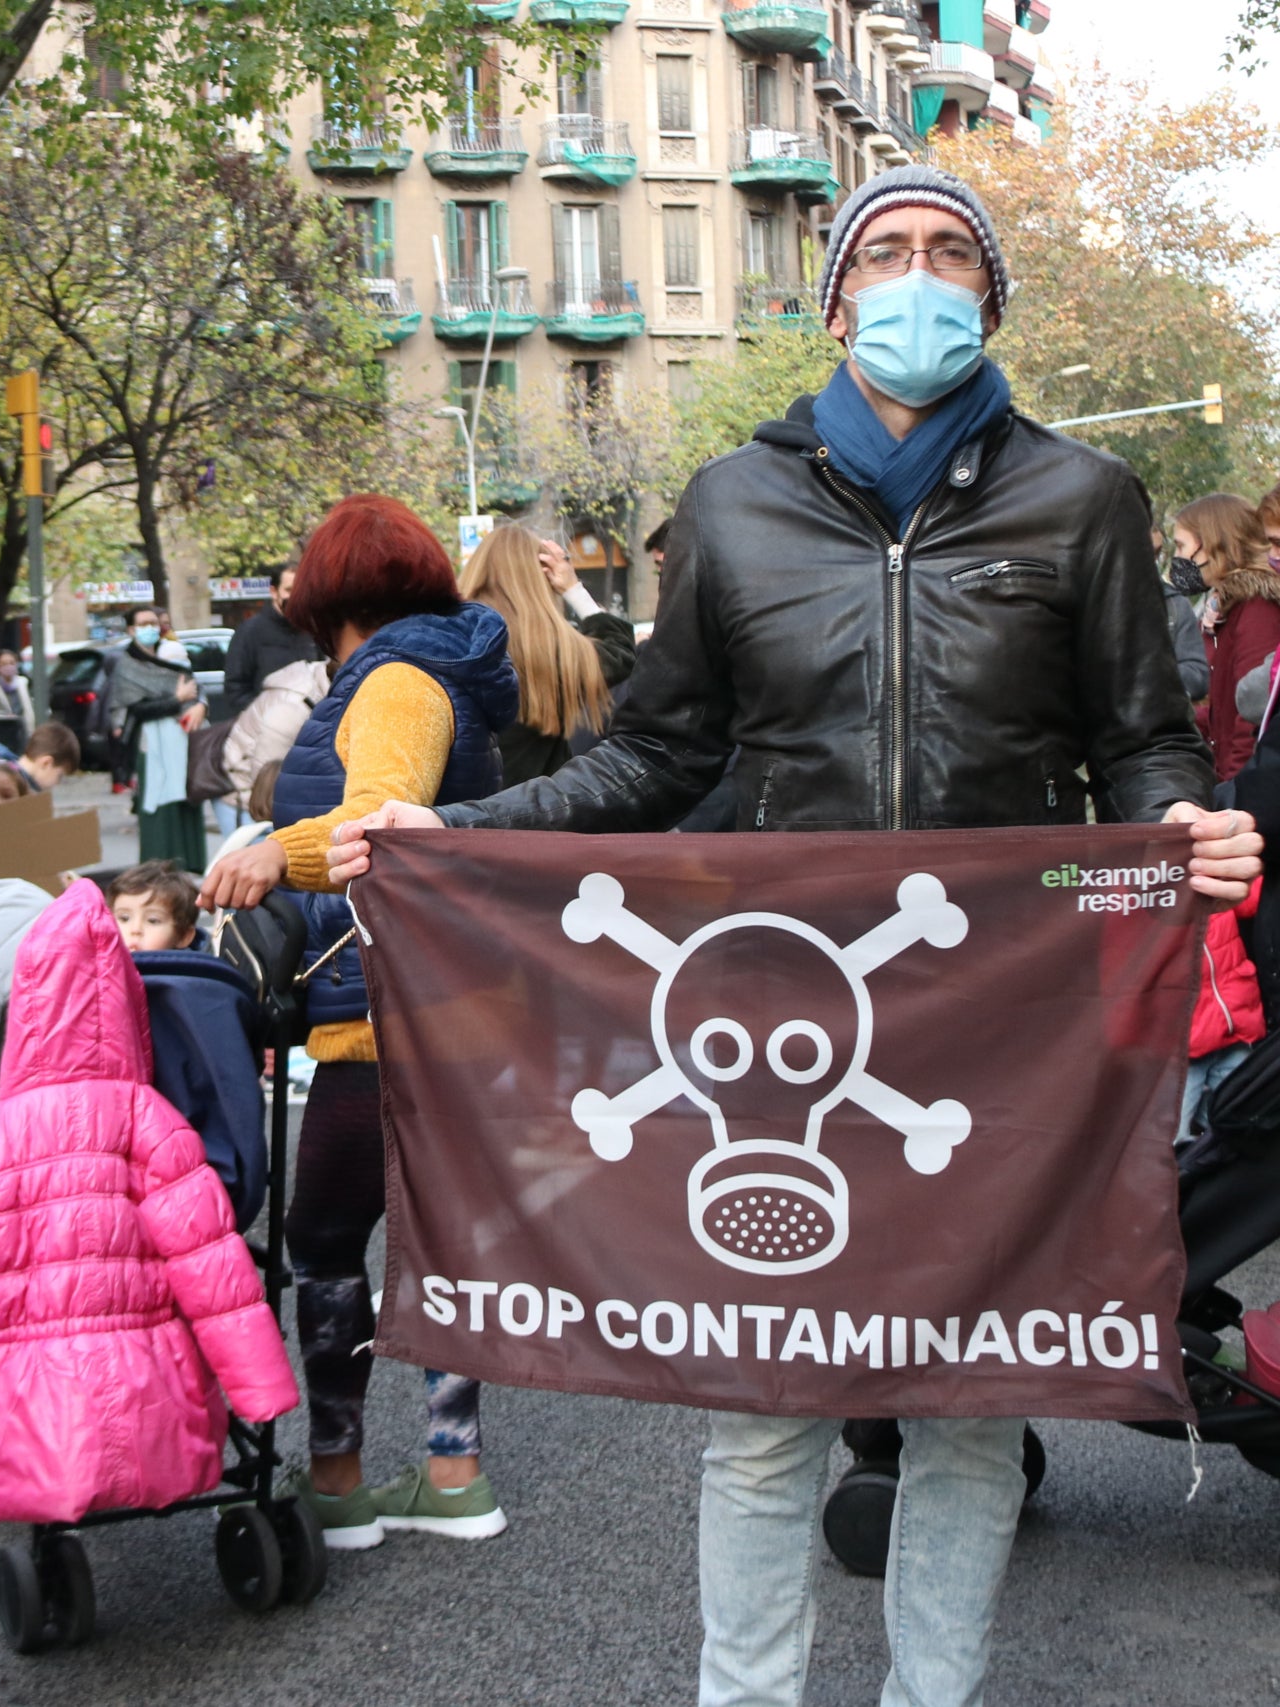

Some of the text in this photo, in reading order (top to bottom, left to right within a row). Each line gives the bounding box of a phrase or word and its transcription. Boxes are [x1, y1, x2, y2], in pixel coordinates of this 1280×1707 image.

[1040, 859, 1186, 892] ei!xample
[1077, 888, 1178, 917] respira
[422, 1274, 1160, 1371] STOP CONTAMINACIÓ!
